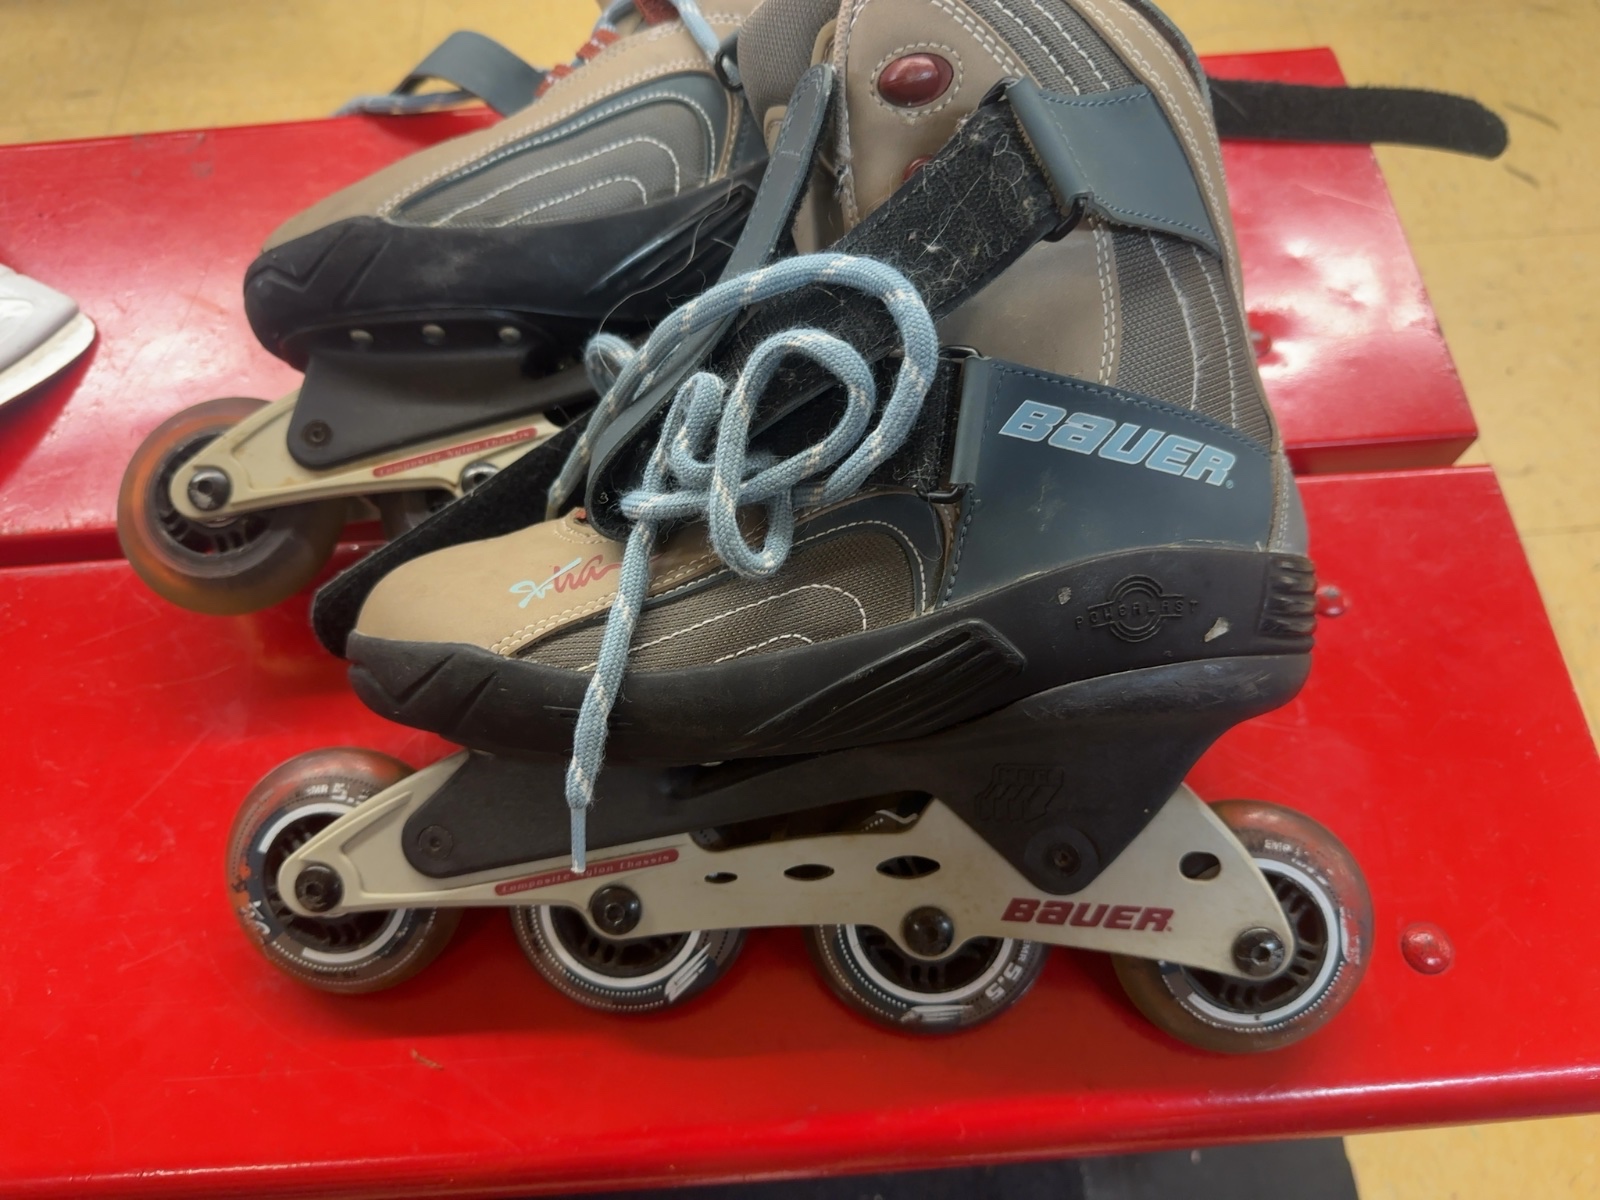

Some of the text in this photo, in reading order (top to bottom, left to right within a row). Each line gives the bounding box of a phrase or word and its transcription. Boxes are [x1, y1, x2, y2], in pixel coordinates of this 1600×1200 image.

[501, 873, 571, 893] Composite
[619, 854, 670, 870] Chassis
[985, 961, 1024, 1001] 5.5
